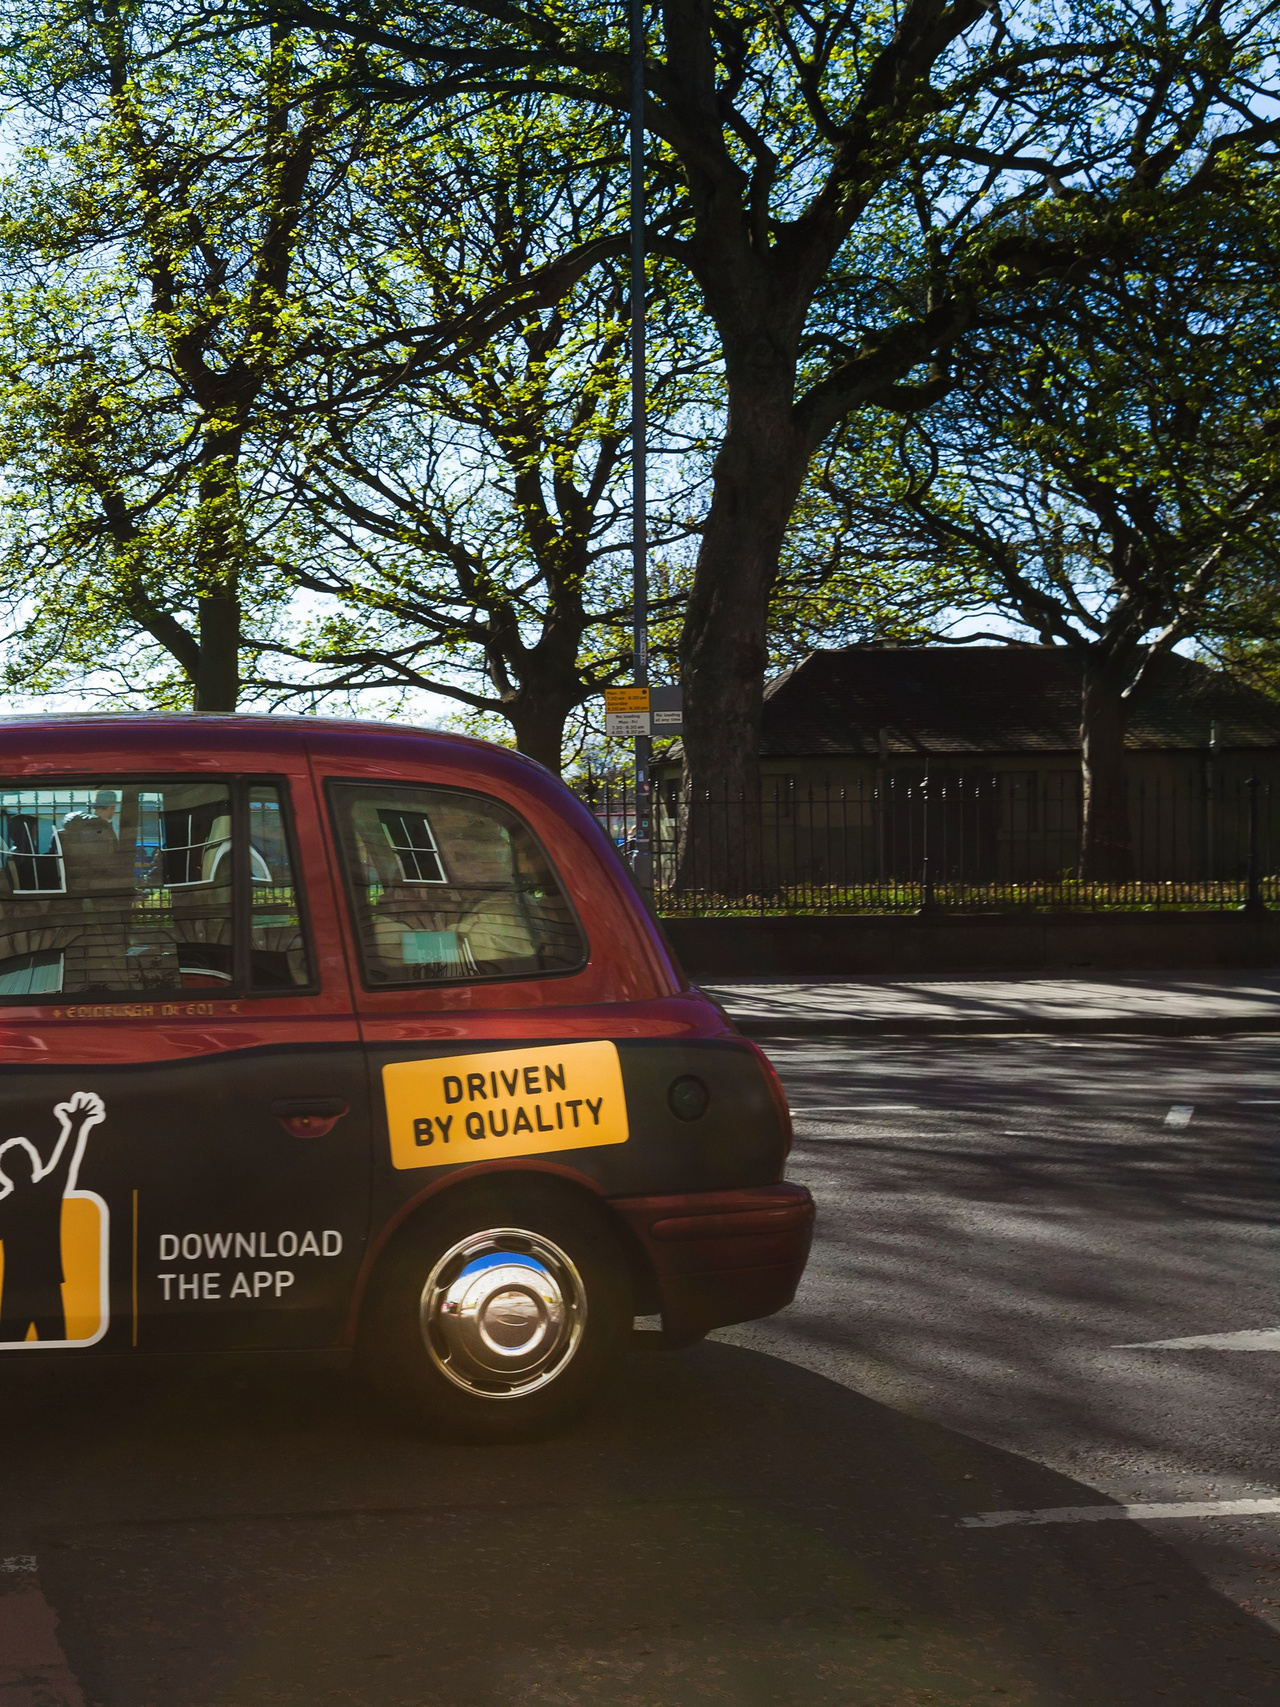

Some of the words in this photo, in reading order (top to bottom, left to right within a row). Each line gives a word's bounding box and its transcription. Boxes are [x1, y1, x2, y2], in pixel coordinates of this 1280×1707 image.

[186, 1003, 214, 1015] 601
[442, 1063, 566, 1104] DRIVEN
[413, 1114, 453, 1147] BY
[465, 1097, 603, 1140] QUALITY
[159, 1230, 343, 1261] DOWNLOAD
[157, 1272, 221, 1300] THE
[229, 1270, 295, 1299] APP
